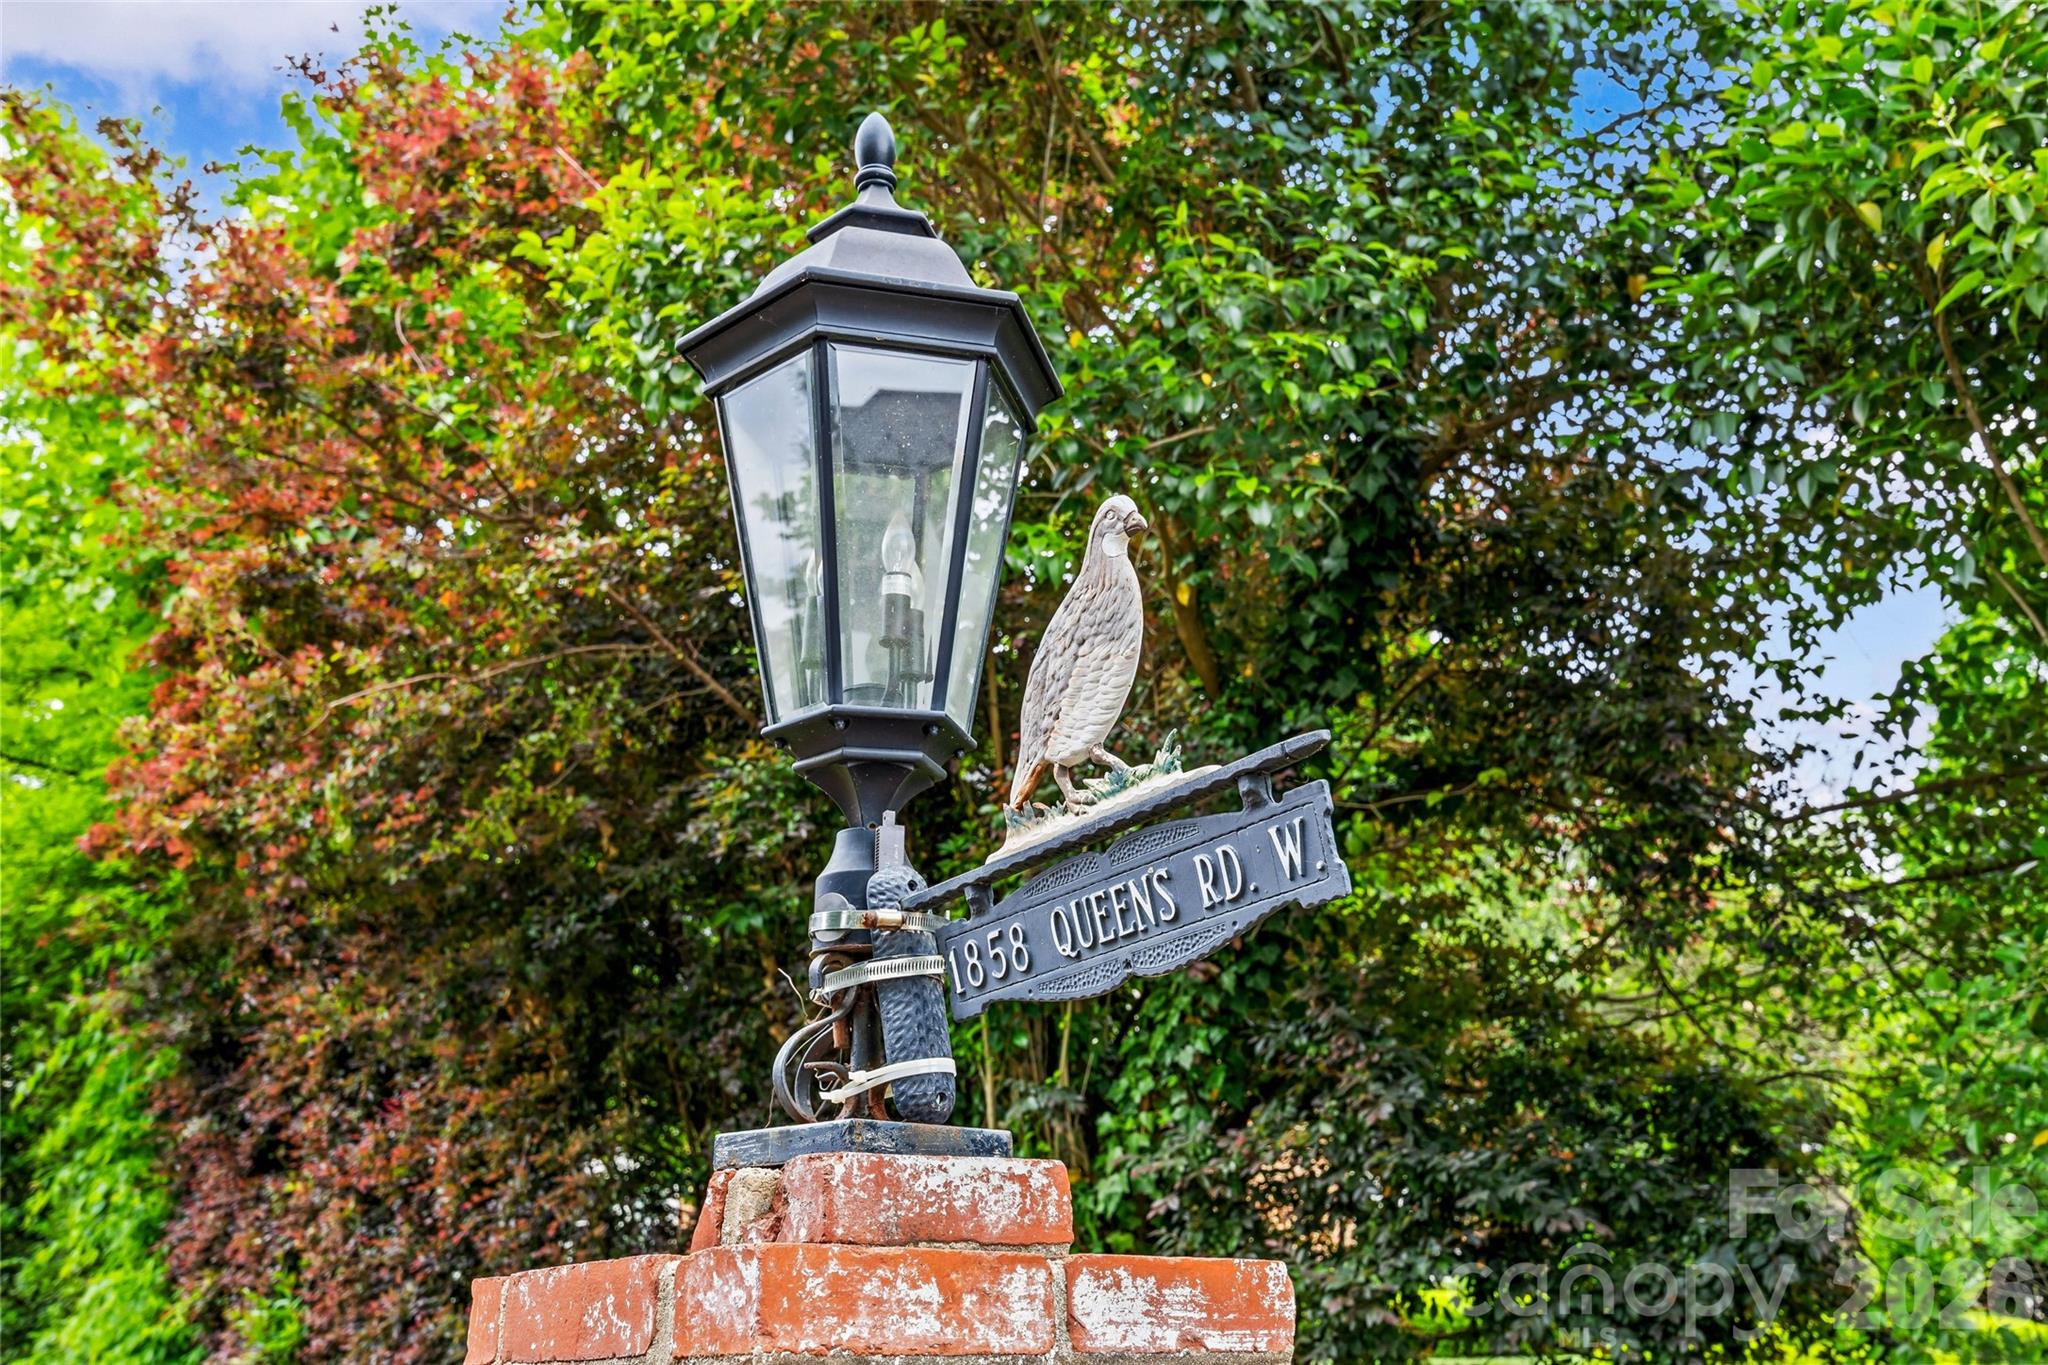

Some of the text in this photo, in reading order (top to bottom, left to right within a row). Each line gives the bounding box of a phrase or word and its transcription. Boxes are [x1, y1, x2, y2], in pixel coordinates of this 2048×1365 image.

[948, 816, 1326, 994] 1858 QUEEN'S RD. W.
